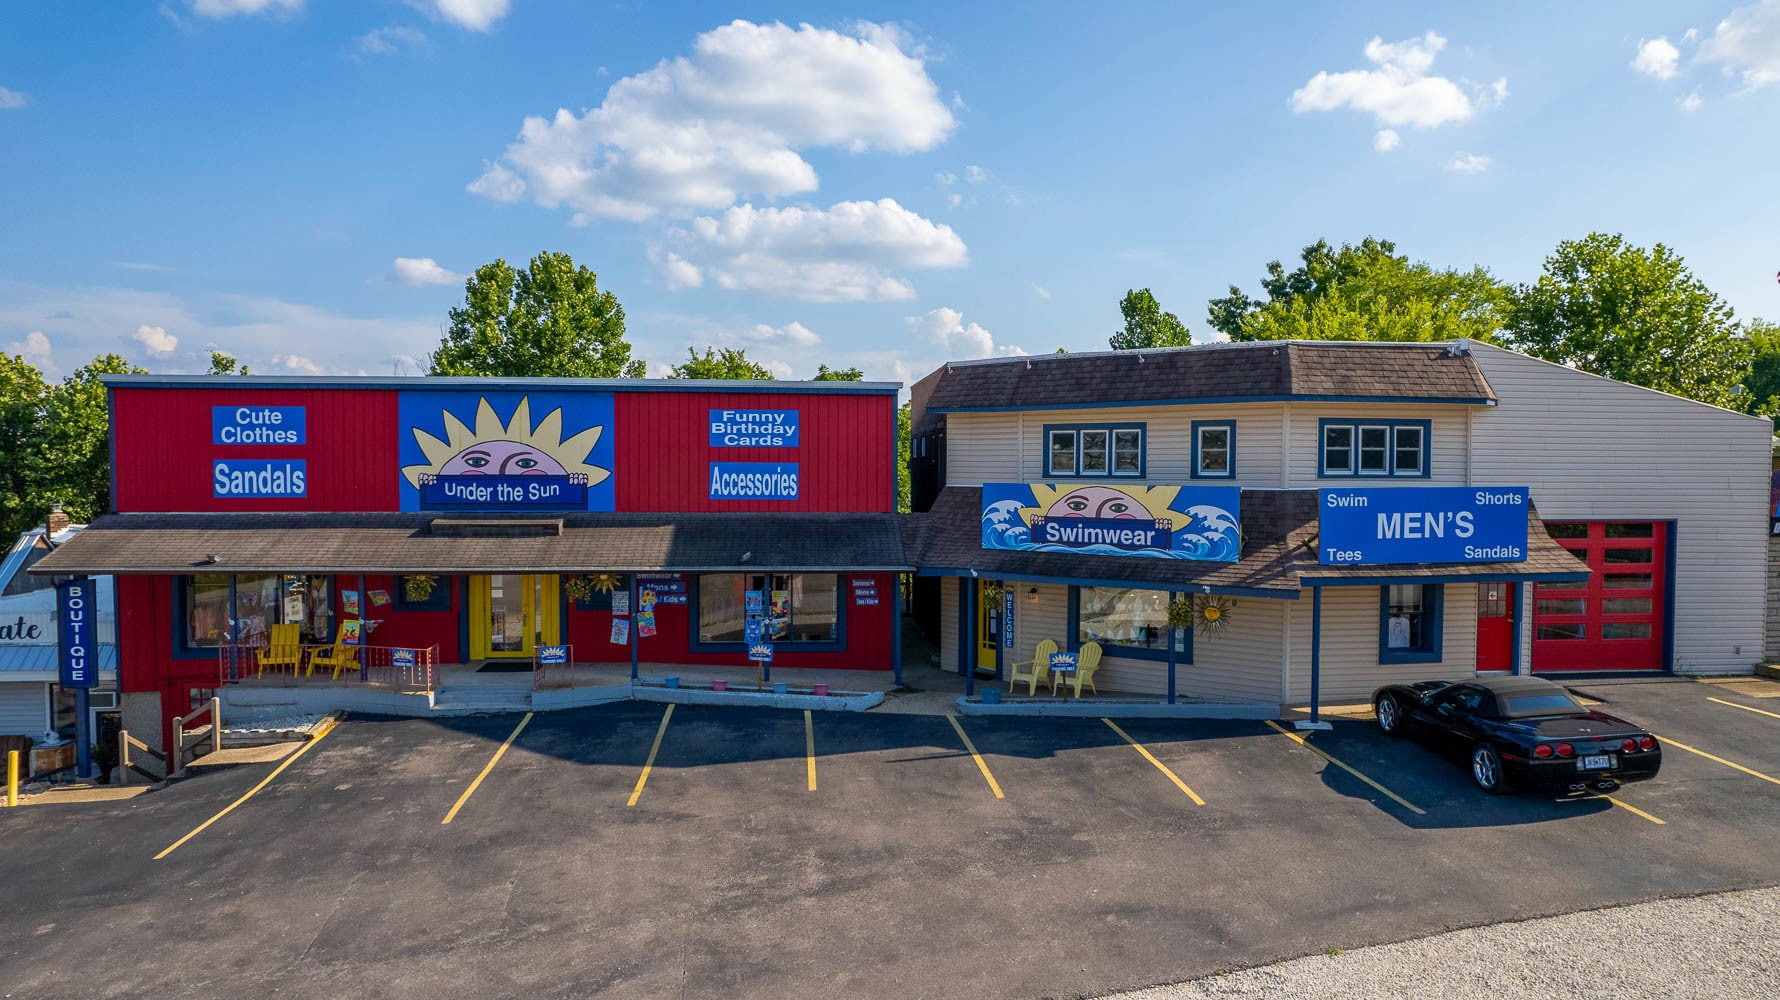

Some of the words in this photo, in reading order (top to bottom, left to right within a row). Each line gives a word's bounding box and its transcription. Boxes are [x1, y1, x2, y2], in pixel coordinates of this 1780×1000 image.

[236, 408, 283, 425] Cute
[722, 411, 785, 425] Funny
[221, 427, 298, 443] Clothes
[711, 422, 796, 437] Birthday
[724, 434, 784, 446] Cards
[214, 463, 305, 495] Sandals
[711, 466, 797, 496] Accessories
[444, 482, 493, 502] Under
[497, 483, 524, 502] the
[528, 482, 560, 501] Sun
[1475, 491, 1522, 505] Shorts
[1327, 493, 1368, 508] Swim
[1377, 510, 1475, 540] MEN'S
[1046, 522, 1155, 546] Swimwear
[1327, 548, 1363, 562] Tees
[1464, 544, 1521, 559] Sandals
[1006, 593, 1014, 648] WELCOME
[69, 586, 85, 681] BOUTIQUE
